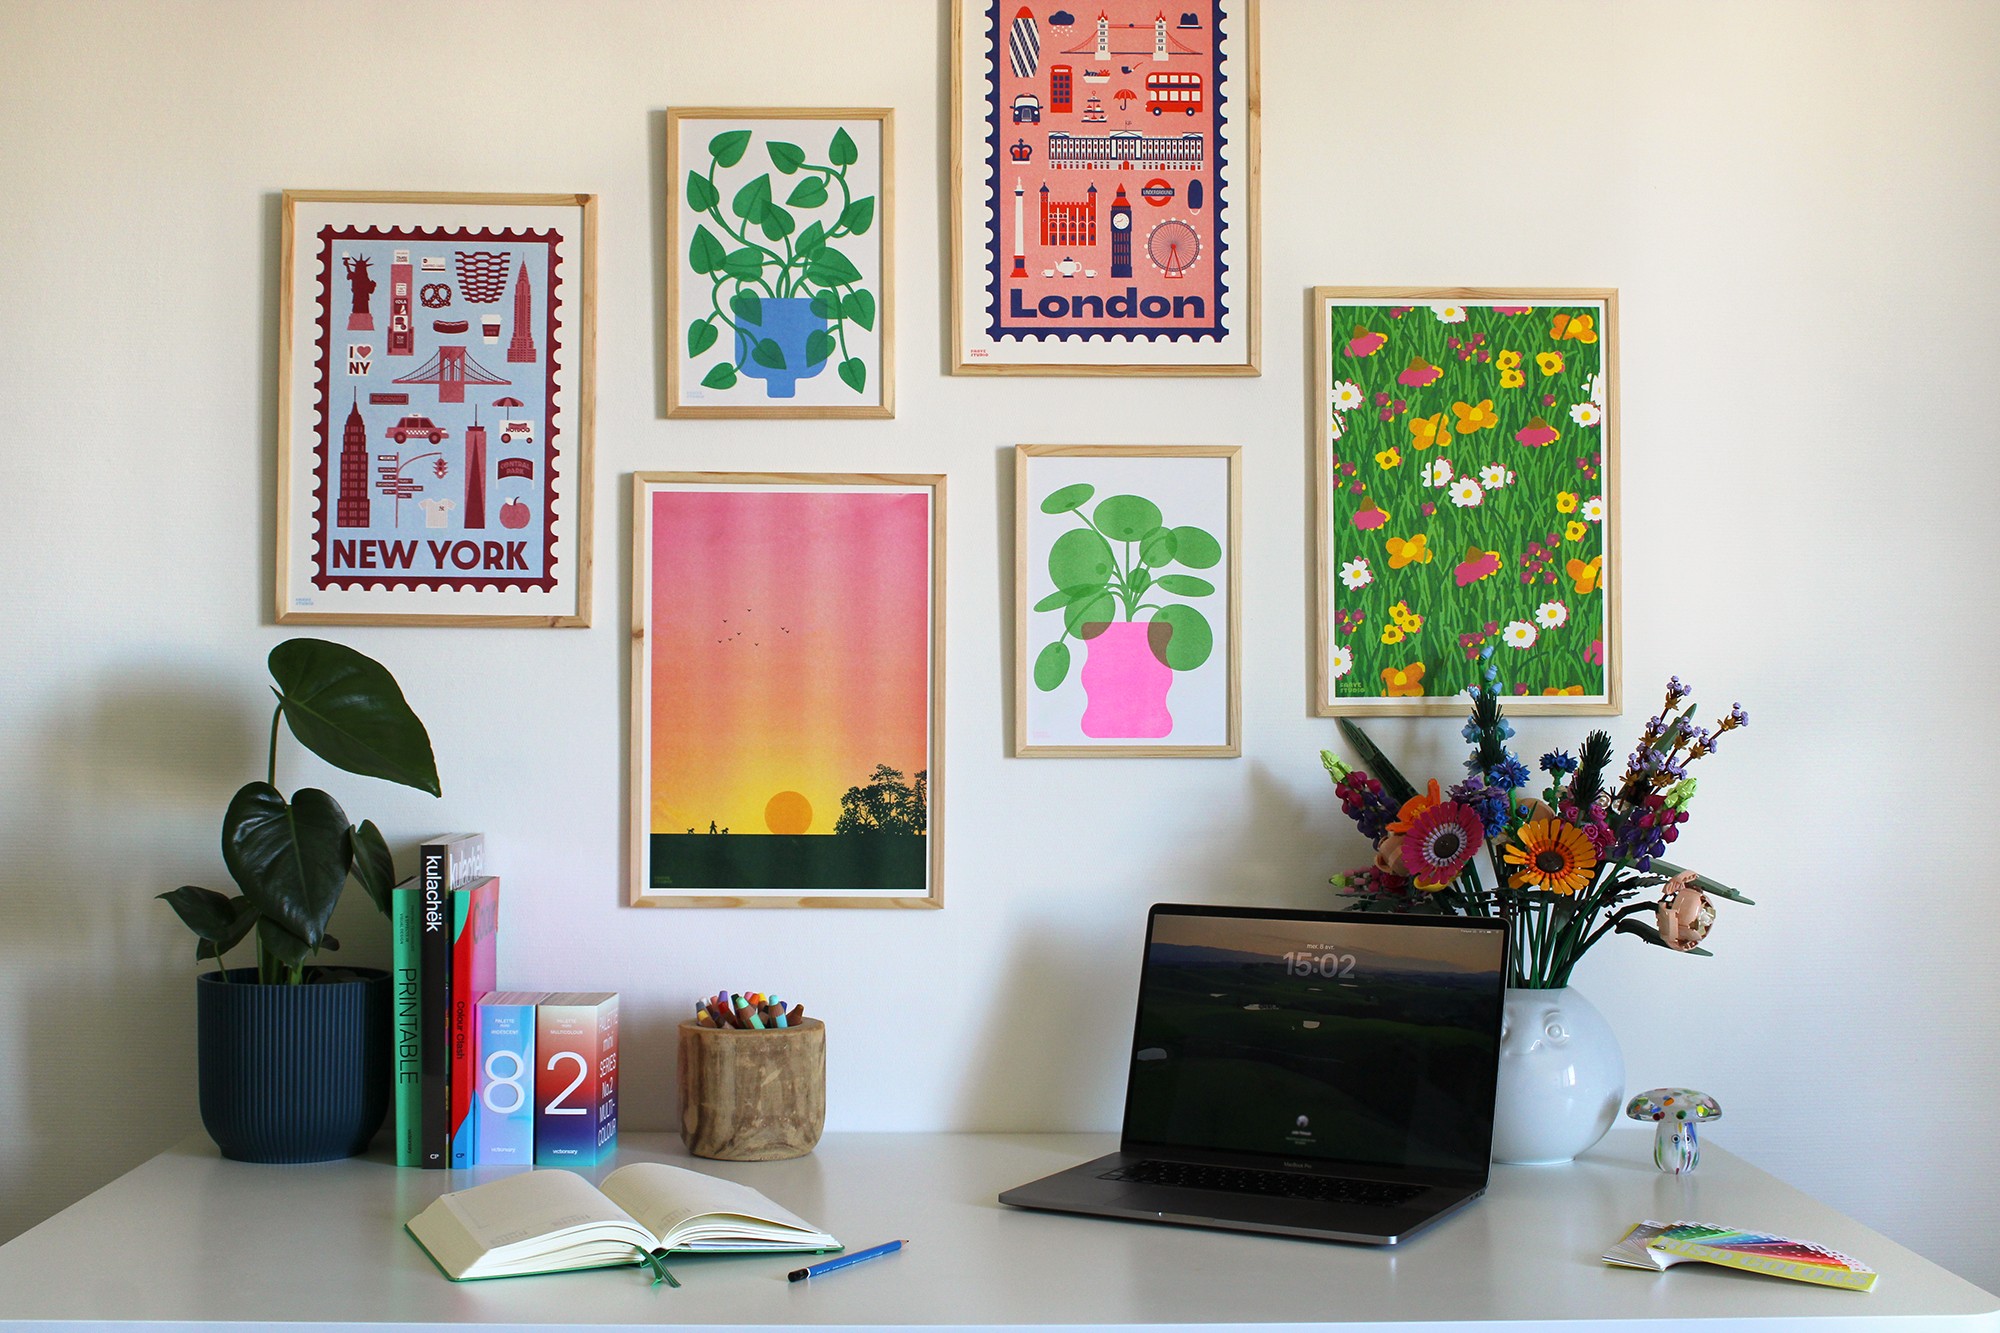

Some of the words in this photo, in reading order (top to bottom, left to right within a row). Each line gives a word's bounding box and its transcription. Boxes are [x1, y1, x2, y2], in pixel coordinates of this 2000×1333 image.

[1010, 287, 1205, 318] London
[349, 361, 371, 375] NY
[500, 460, 531, 470] CENTRAL
[506, 467, 525, 475] PARK
[332, 539, 419, 569] NEW
[426, 540, 530, 570] YORK
[426, 855, 442, 933] kulachëk
[1282, 951, 1356, 979] 15:02
[399, 968, 418, 1084] PRINTABLE
[456, 1001, 465, 1031] Colour
[456, 1033, 465, 1060] Clash
[600, 1053, 617, 1078] SERIES
[483, 1049, 526, 1114] 8
[544, 1051, 588, 1115] 2
[1656, 1236, 1733, 1262] RISO
[1740, 1256, 1871, 1287] COLORS
